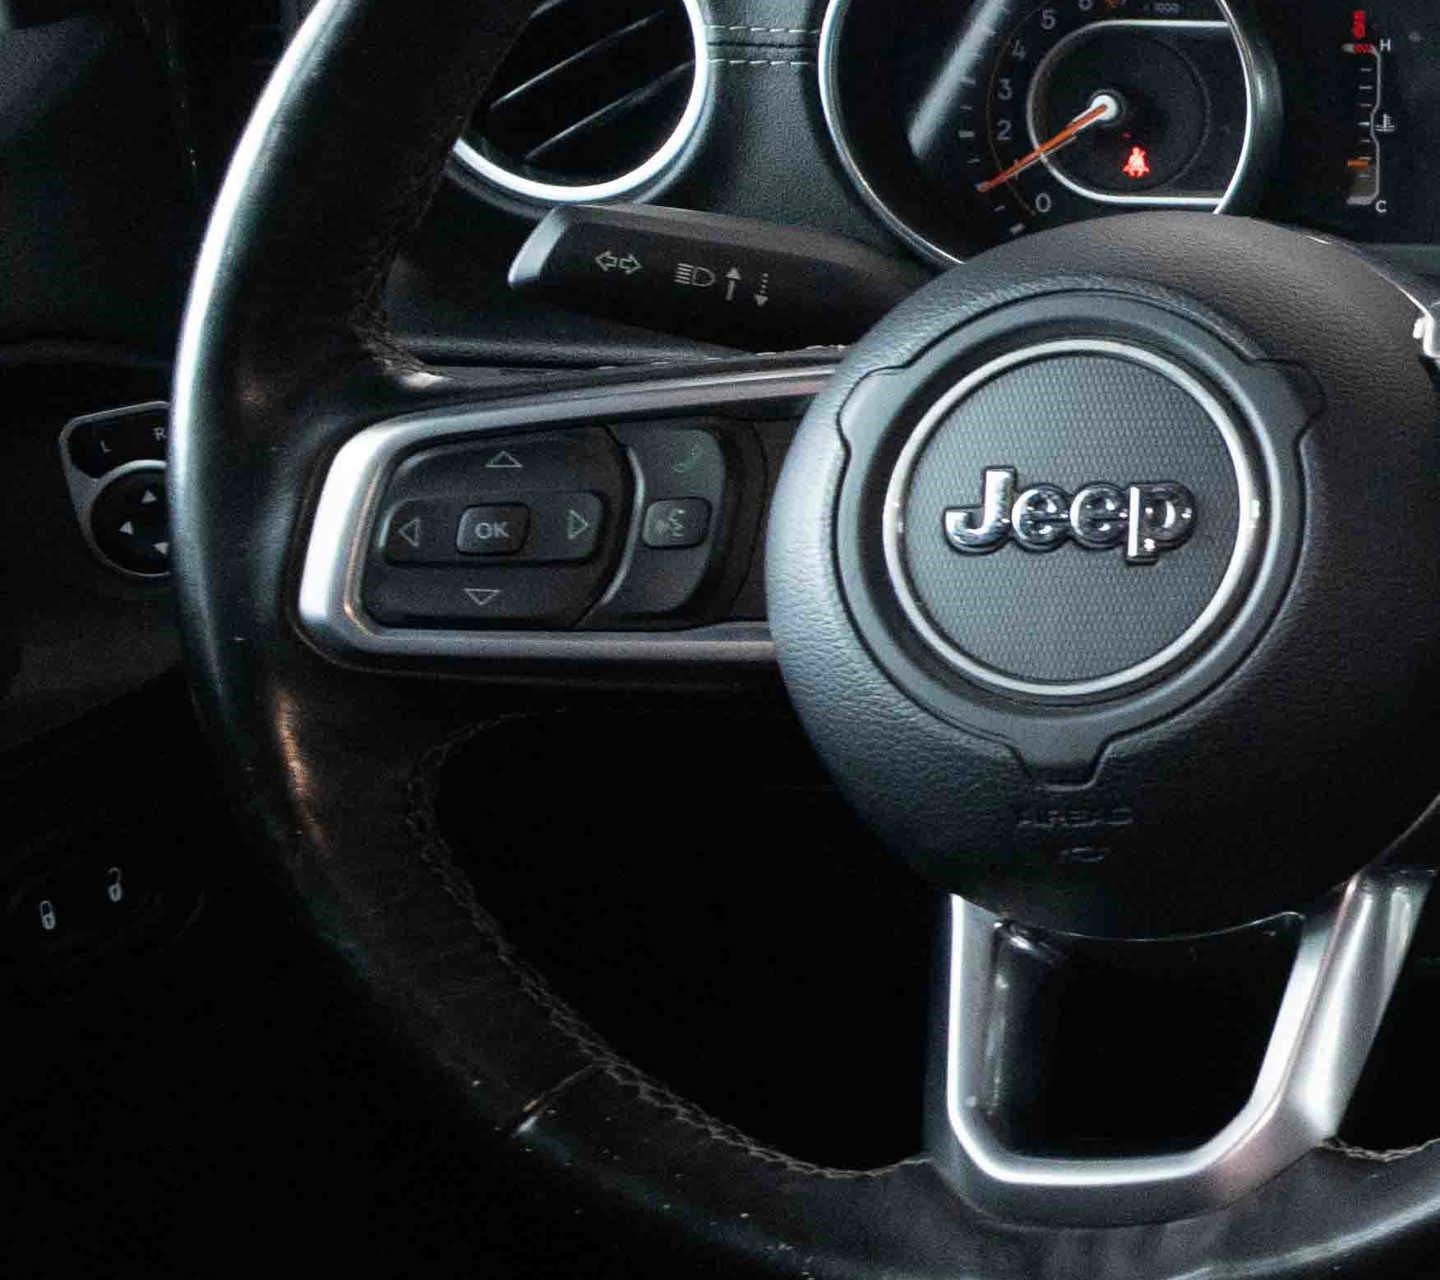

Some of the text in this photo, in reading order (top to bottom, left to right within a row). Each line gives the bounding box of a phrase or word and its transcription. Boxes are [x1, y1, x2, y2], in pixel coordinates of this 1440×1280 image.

[1041, 9, 1055, 29] 5
[1012, 40, 1026, 59] 4
[997, 80, 1013, 101] 3
[997, 121, 1012, 141] 2
[1035, 192, 1052, 214] 0
[944, 468, 1196, 563] Jeep
[473, 521, 510, 540] OK
